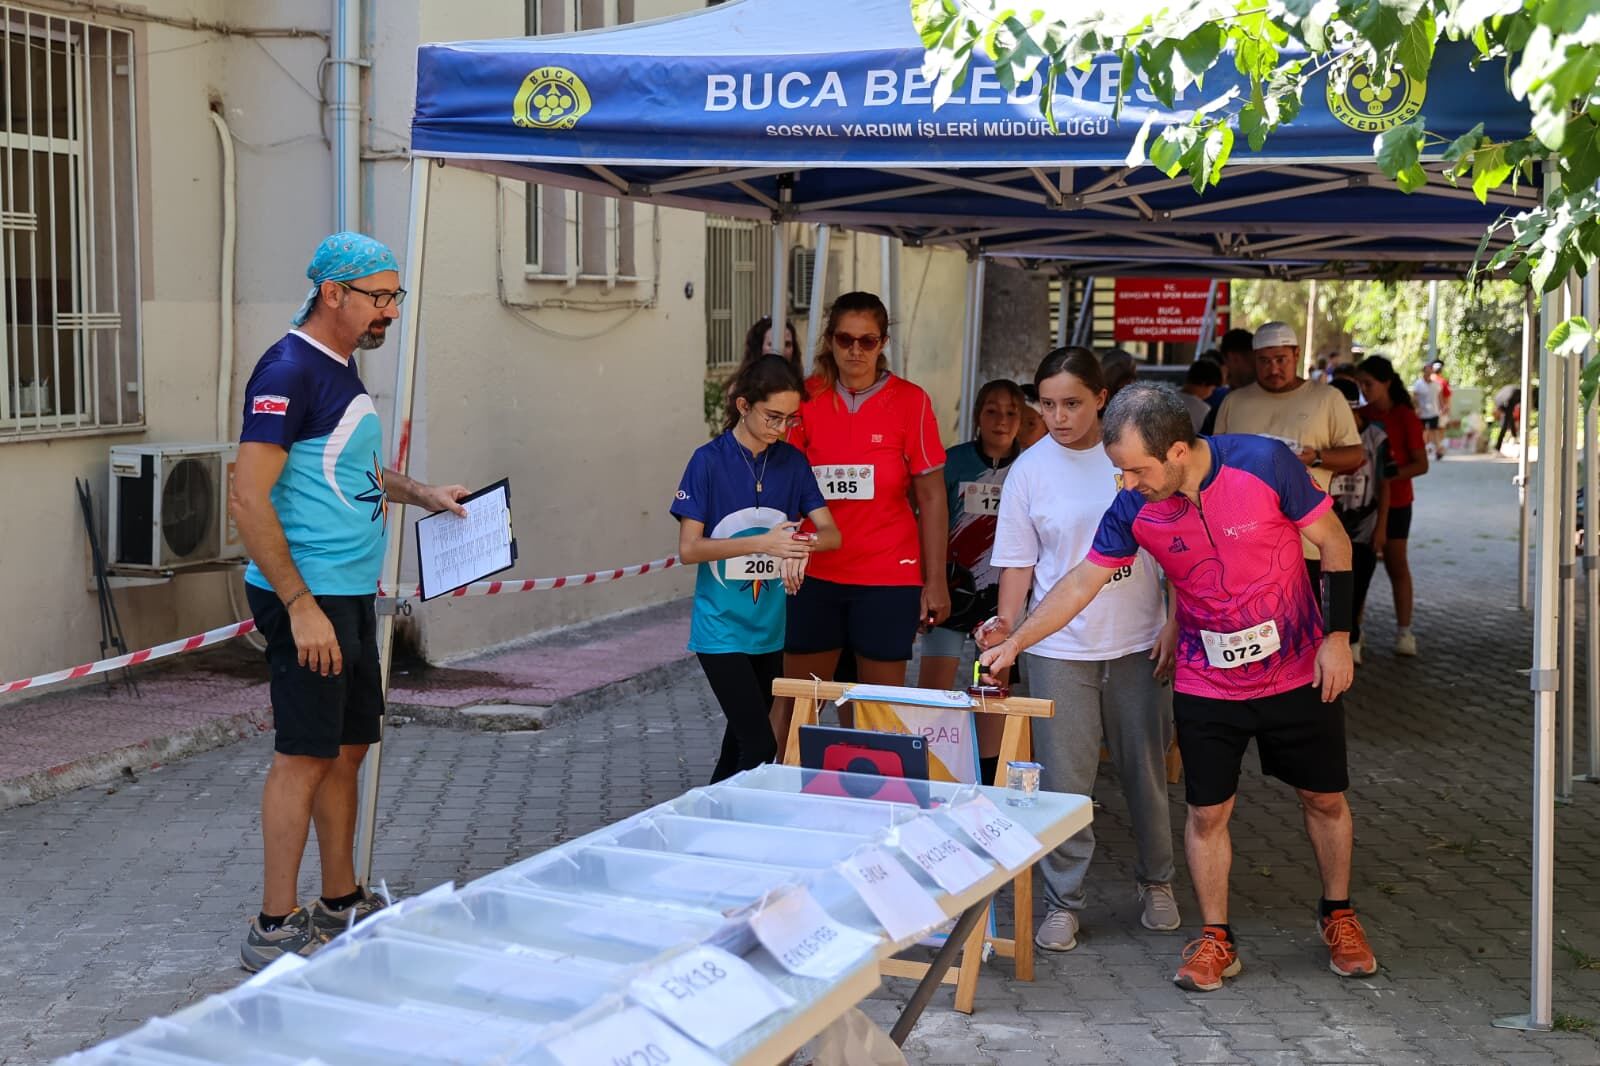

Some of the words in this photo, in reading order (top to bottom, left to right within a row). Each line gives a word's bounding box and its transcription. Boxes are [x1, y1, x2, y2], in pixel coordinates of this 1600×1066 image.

[530, 69, 574, 85] BUCA
[704, 70, 848, 112] BUCA
[766, 124, 838, 137] SOSYAL
[842, 122, 912, 137] YARDIM
[917, 119, 978, 138] İŞLERİ
[984, 116, 1109, 137] MÜDÜRLÜĞÜ
[1157, 307, 1181, 315] BUCA
[1117, 317, 1154, 325] MUSTAFA
[1156, 317, 1184, 325] KEMAL
[826, 481, 858, 494] 185
[744, 560, 774, 574] 206
[1222, 643, 1262, 662] 072
[660, 960, 727, 1002] E/K18
